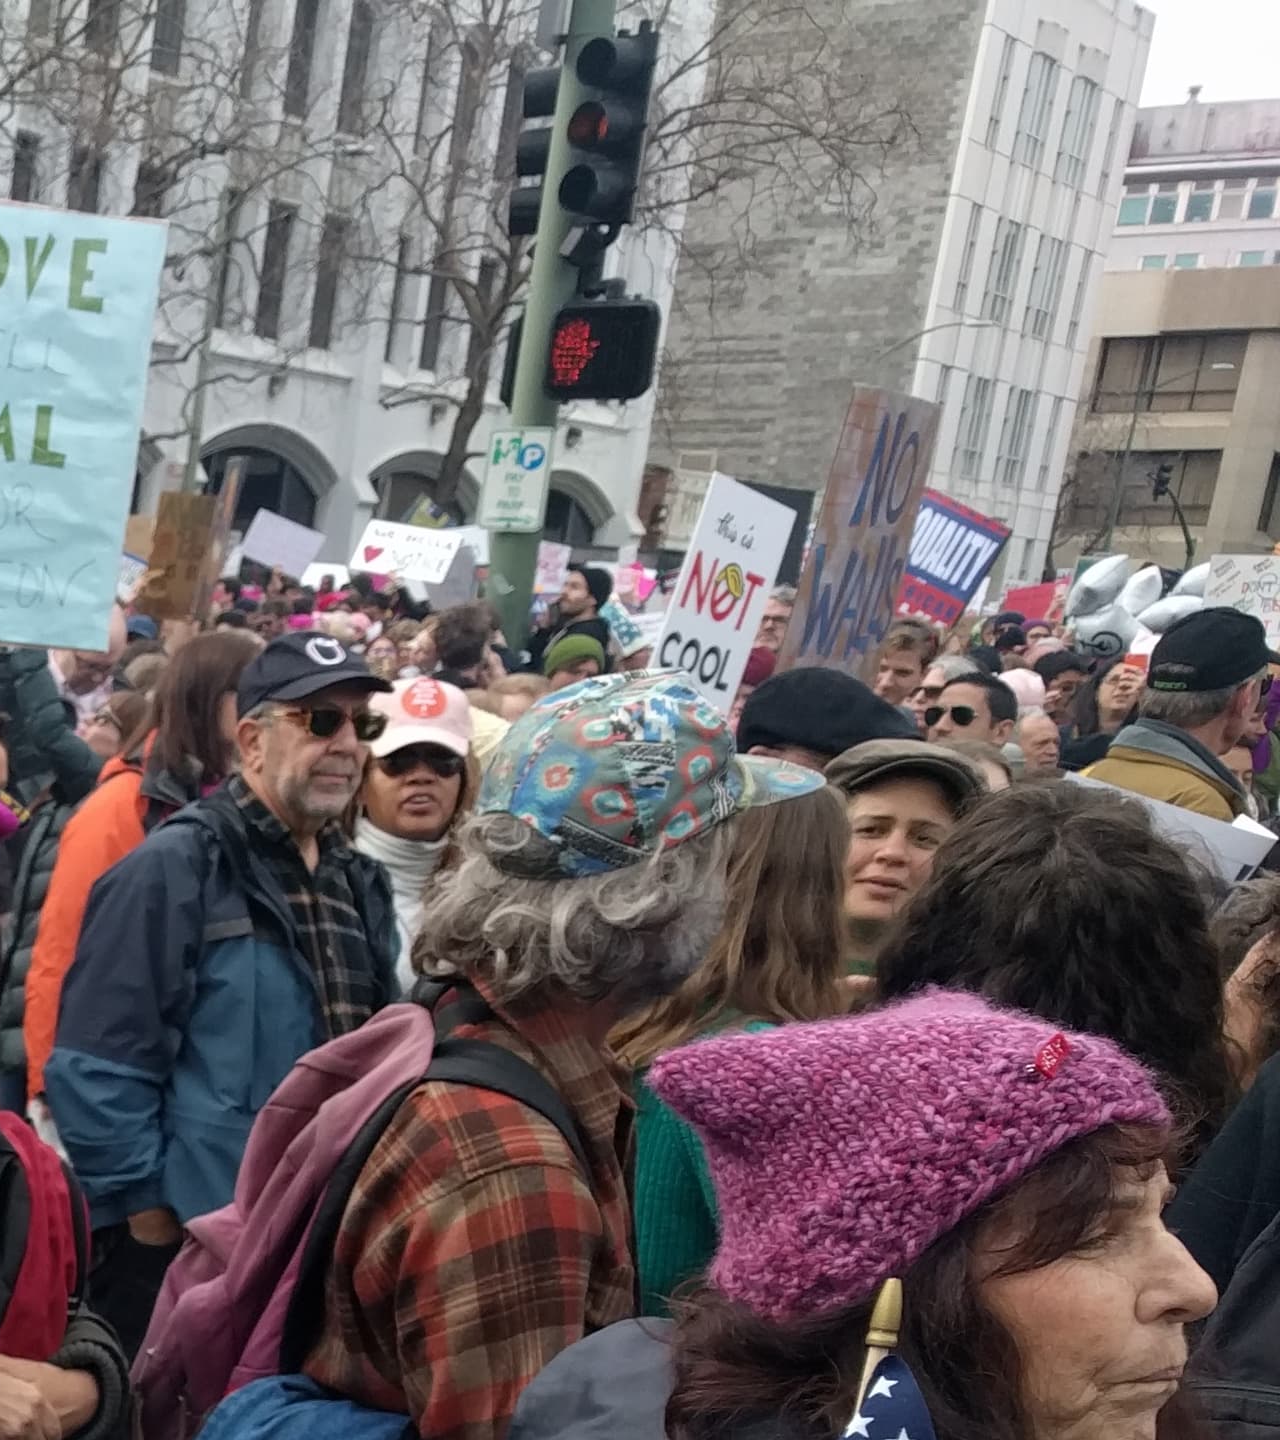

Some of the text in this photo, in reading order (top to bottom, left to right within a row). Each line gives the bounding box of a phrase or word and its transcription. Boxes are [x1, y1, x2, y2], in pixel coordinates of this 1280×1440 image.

[847, 411, 921, 529] NO
[679, 549, 766, 632] NOT
[908, 505, 1000, 592] QUALITY
[659, 631, 732, 692] COOL
